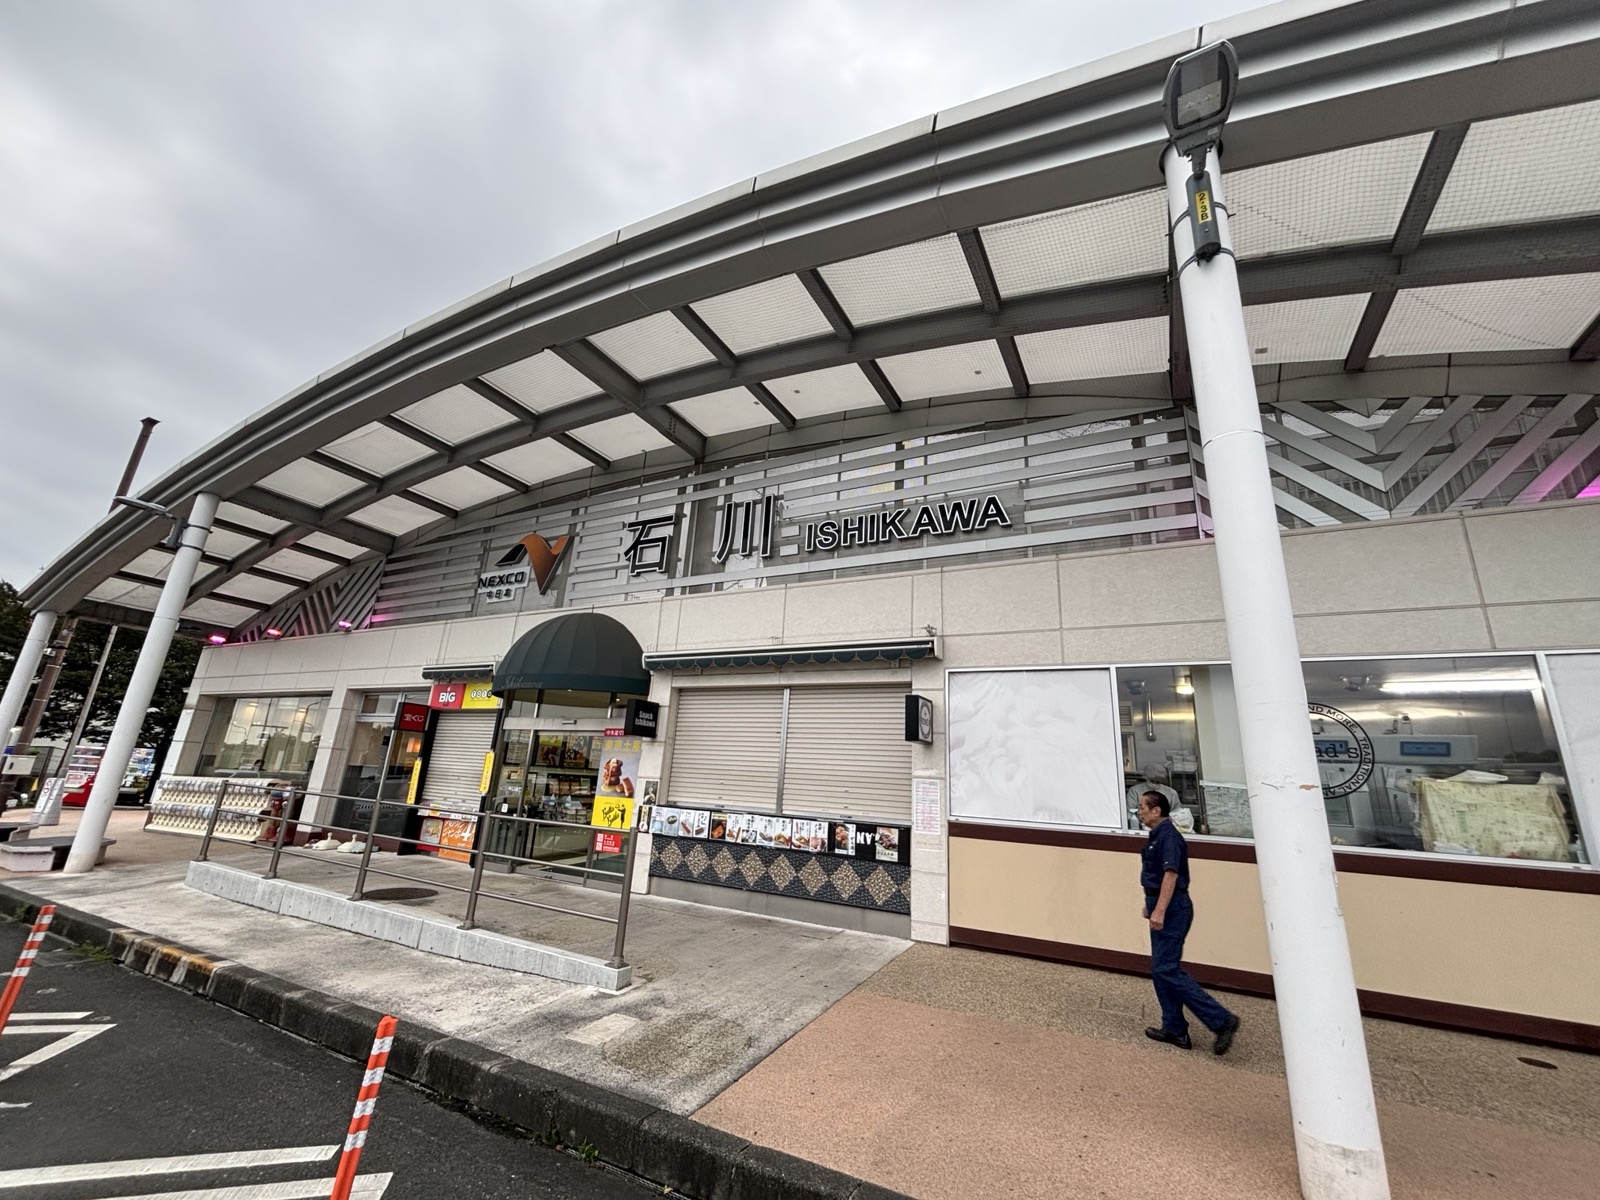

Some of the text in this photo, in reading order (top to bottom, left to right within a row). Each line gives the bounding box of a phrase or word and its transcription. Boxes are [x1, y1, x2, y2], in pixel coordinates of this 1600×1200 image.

[805, 495, 1011, 552] ISHIKAWA
[624, 494, 774, 576] 石川
[478, 571, 525, 588] NEXCO
[501, 676, 543, 689] Ishikawa
[404, 713, 425, 722] 宝くじ
[634, 718, 656, 728] Ishikawa
[639, 711, 653, 720] Snack
[1308, 704, 1323, 712] ND
[1338, 737, 1371, 794] TRADITIONAL
[1315, 743, 1360, 759] ad's
